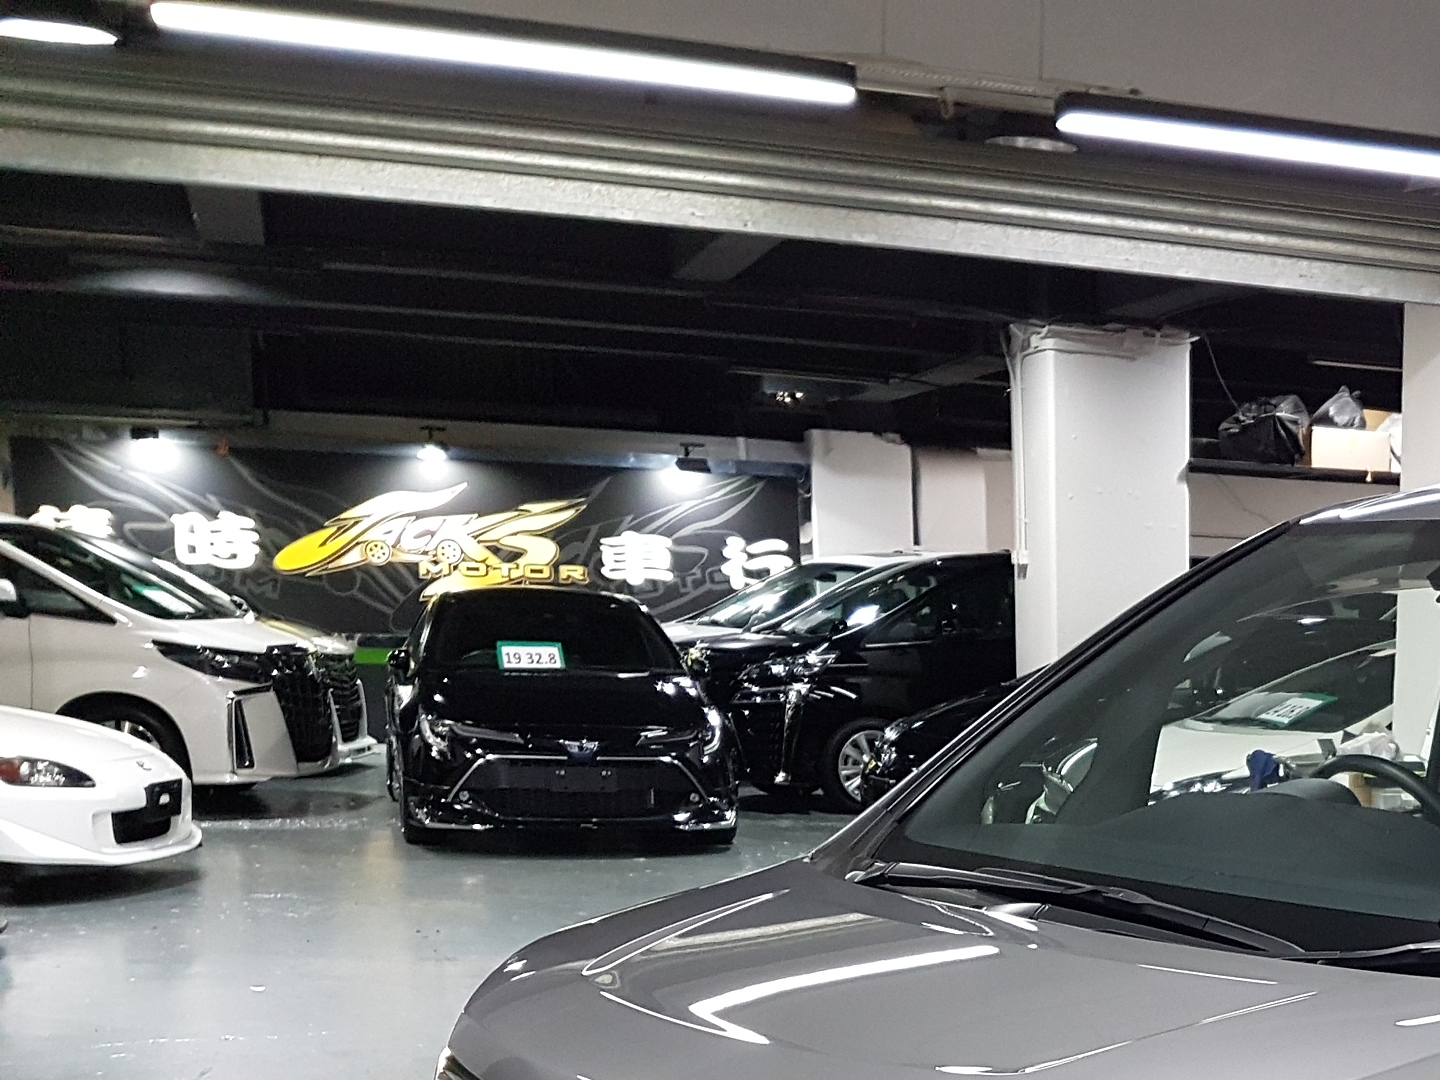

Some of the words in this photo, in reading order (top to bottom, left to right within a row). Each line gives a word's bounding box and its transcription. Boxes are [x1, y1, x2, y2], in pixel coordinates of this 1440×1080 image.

[599, 530, 794, 589] 車行
[418, 560, 590, 584] MOTOR
[504, 651, 522, 664] 19
[525, 652, 557, 665] 32.8
